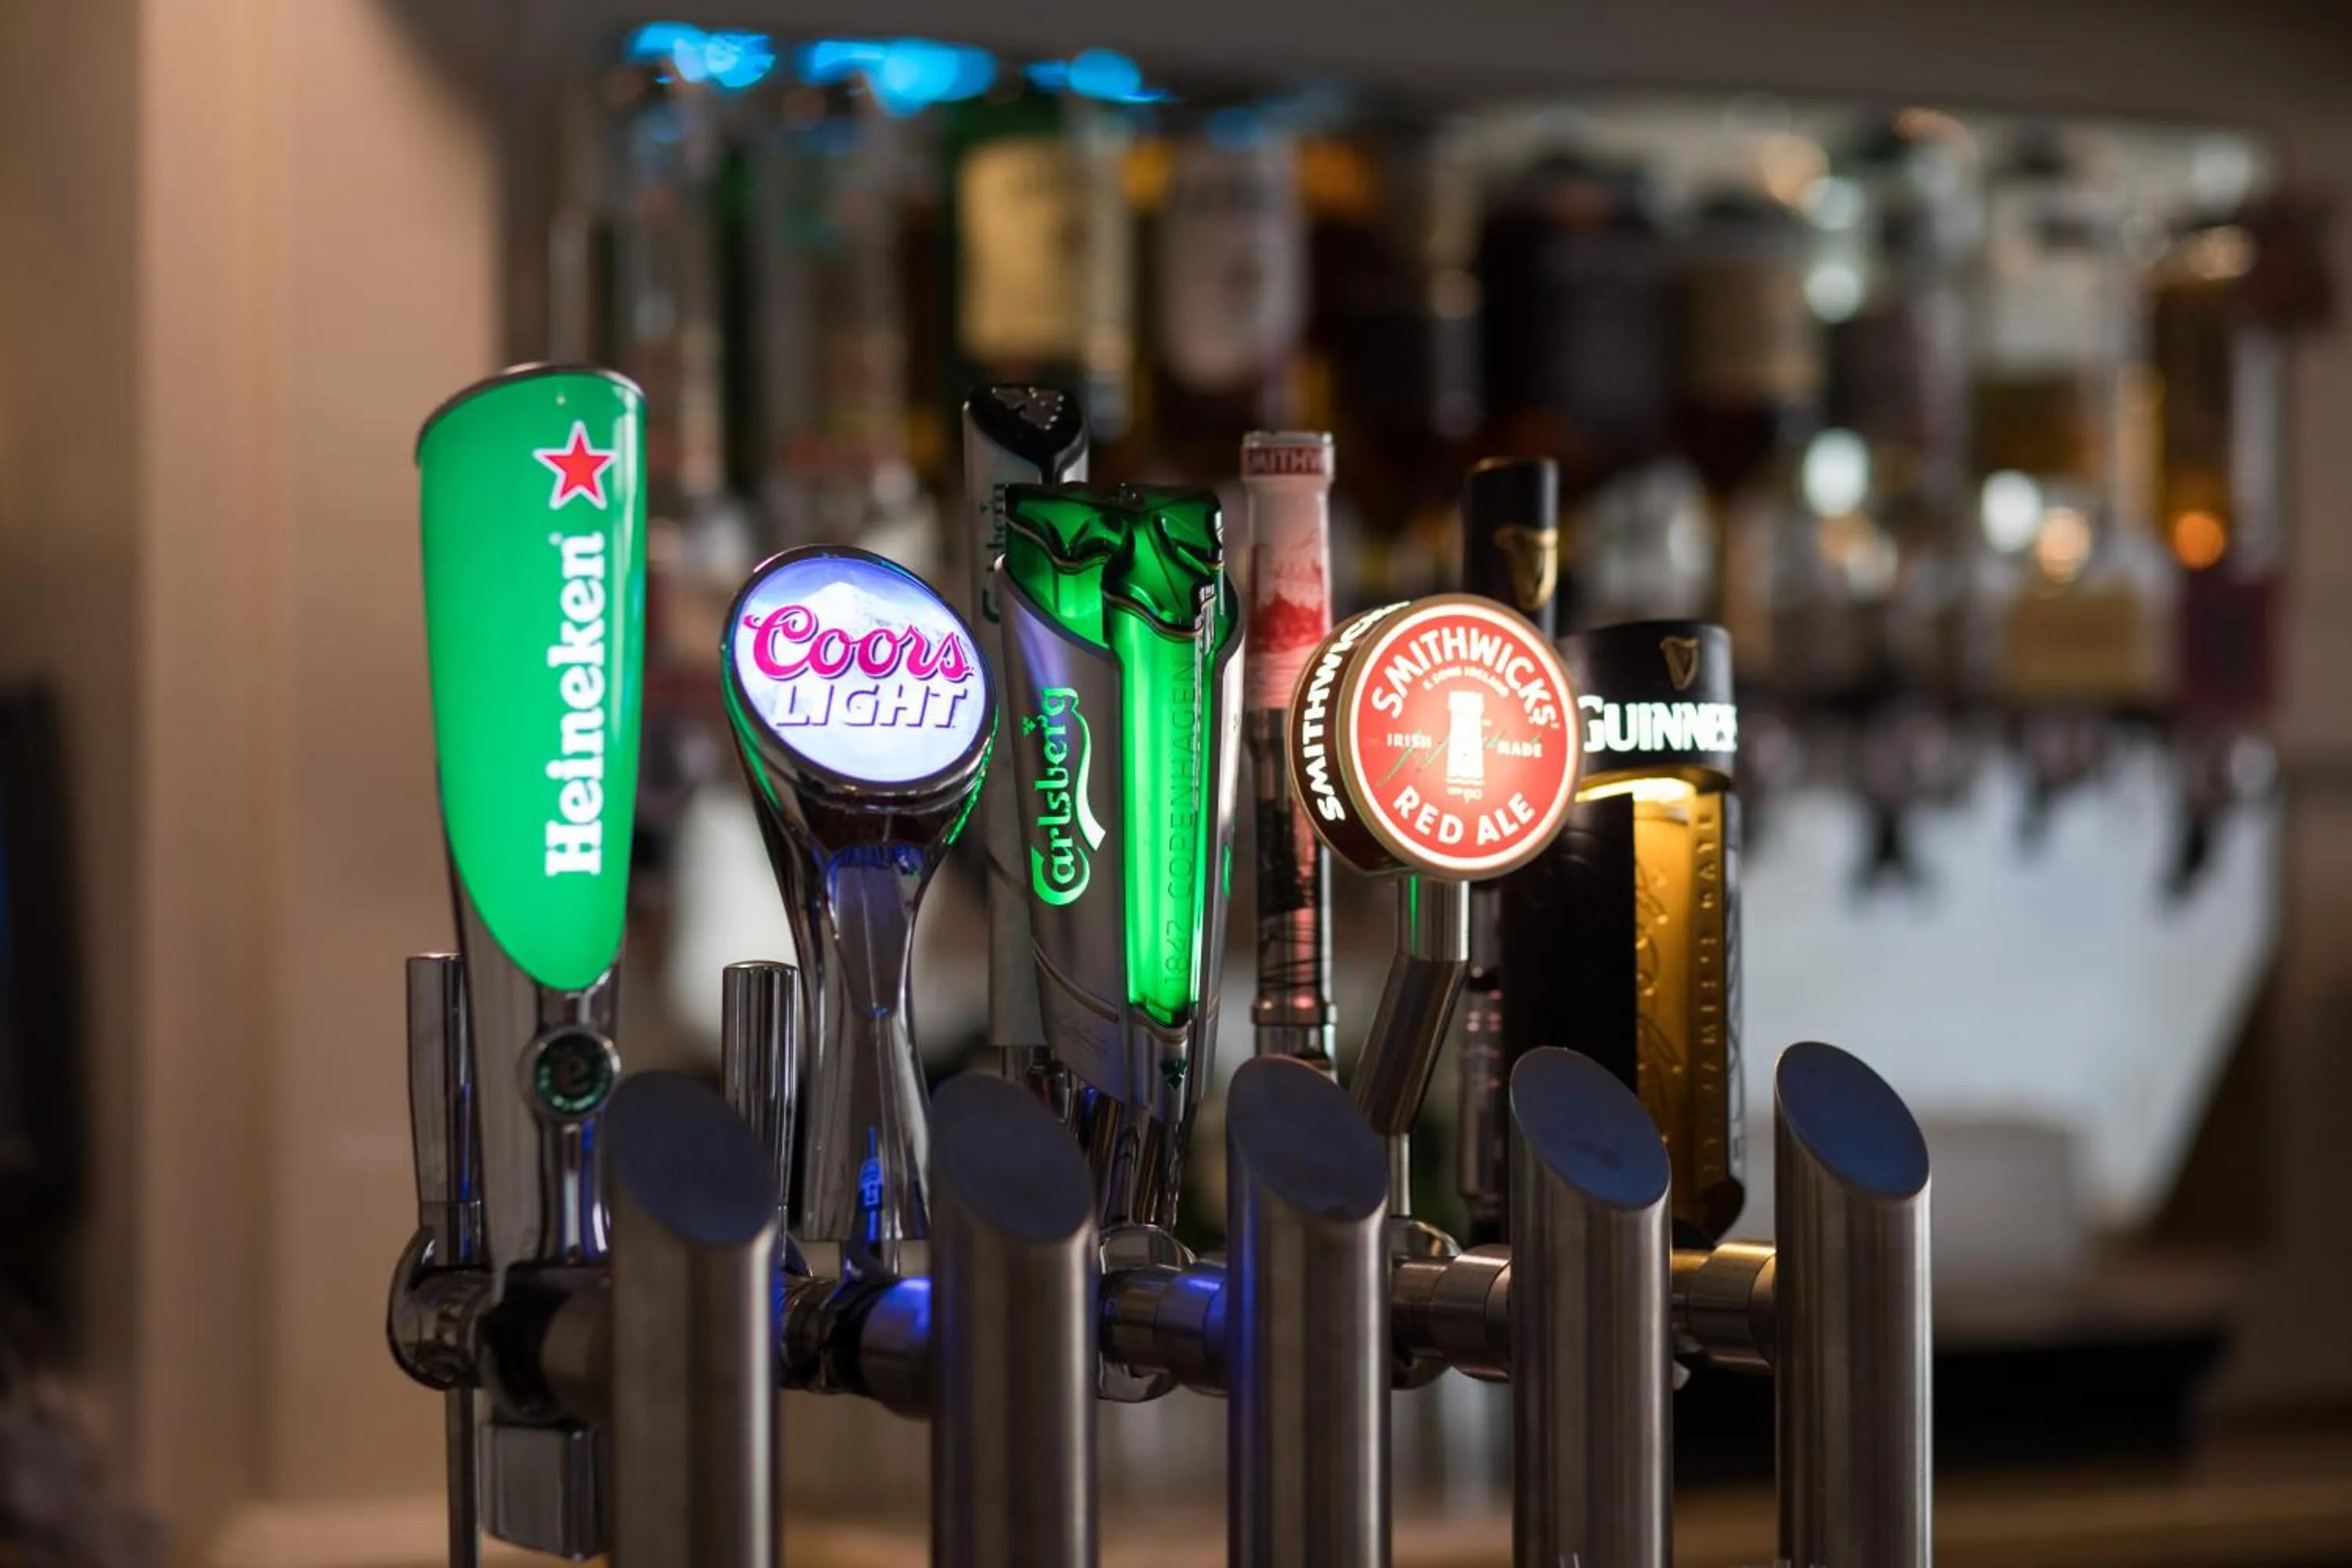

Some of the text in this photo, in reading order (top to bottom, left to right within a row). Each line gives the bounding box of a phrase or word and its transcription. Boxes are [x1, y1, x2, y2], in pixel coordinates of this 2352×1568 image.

[743, 604, 974, 683] Coors
[545, 532, 605, 877] Heineken
[775, 684, 968, 728] LIGHT
[1167, 660, 1196, 900] COPENHAGEN
[1387, 733, 1543, 759] IRISH MADE
[1031, 687, 1106, 906] Carlsberg
[1393, 785, 1536, 846] RED ALE
